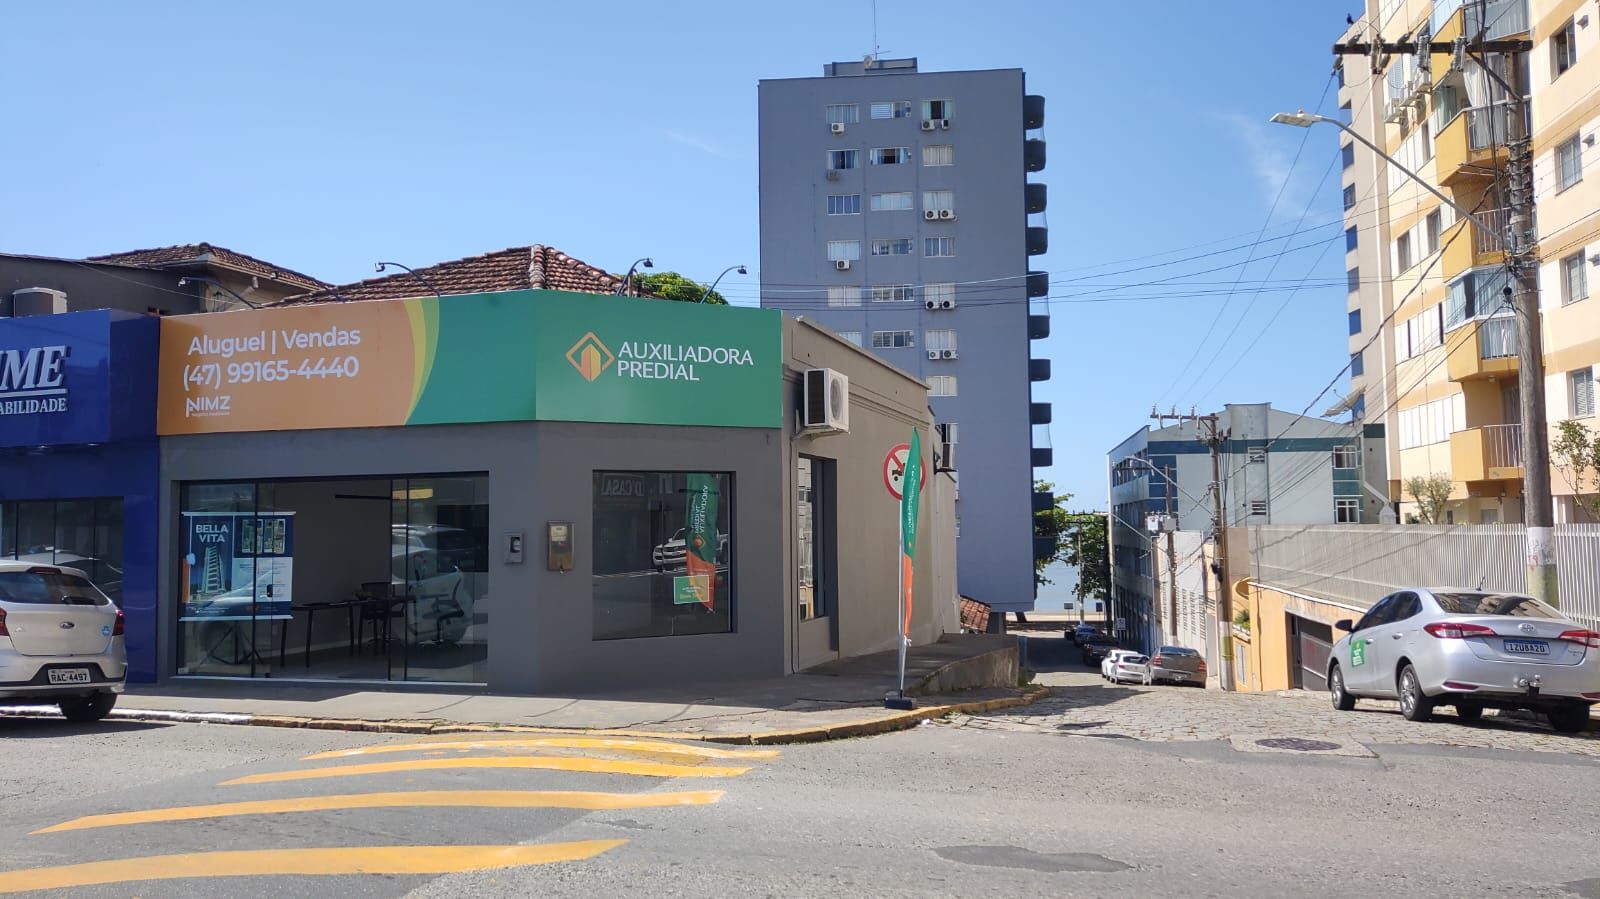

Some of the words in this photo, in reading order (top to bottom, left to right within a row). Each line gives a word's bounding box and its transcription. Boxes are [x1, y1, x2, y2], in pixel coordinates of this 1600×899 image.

[187, 330, 266, 358] Aluguel
[281, 325, 361, 350] Vendas
[618, 341, 754, 366] AUXILIADORA
[183, 362, 222, 391] (47)
[227, 355, 360, 384] 99165-4440
[617, 360, 700, 381] PREDIAL
[186, 395, 231, 418] NIMZ
[195, 524, 229, 534] BELLA
[199, 534, 226, 543] VITA
